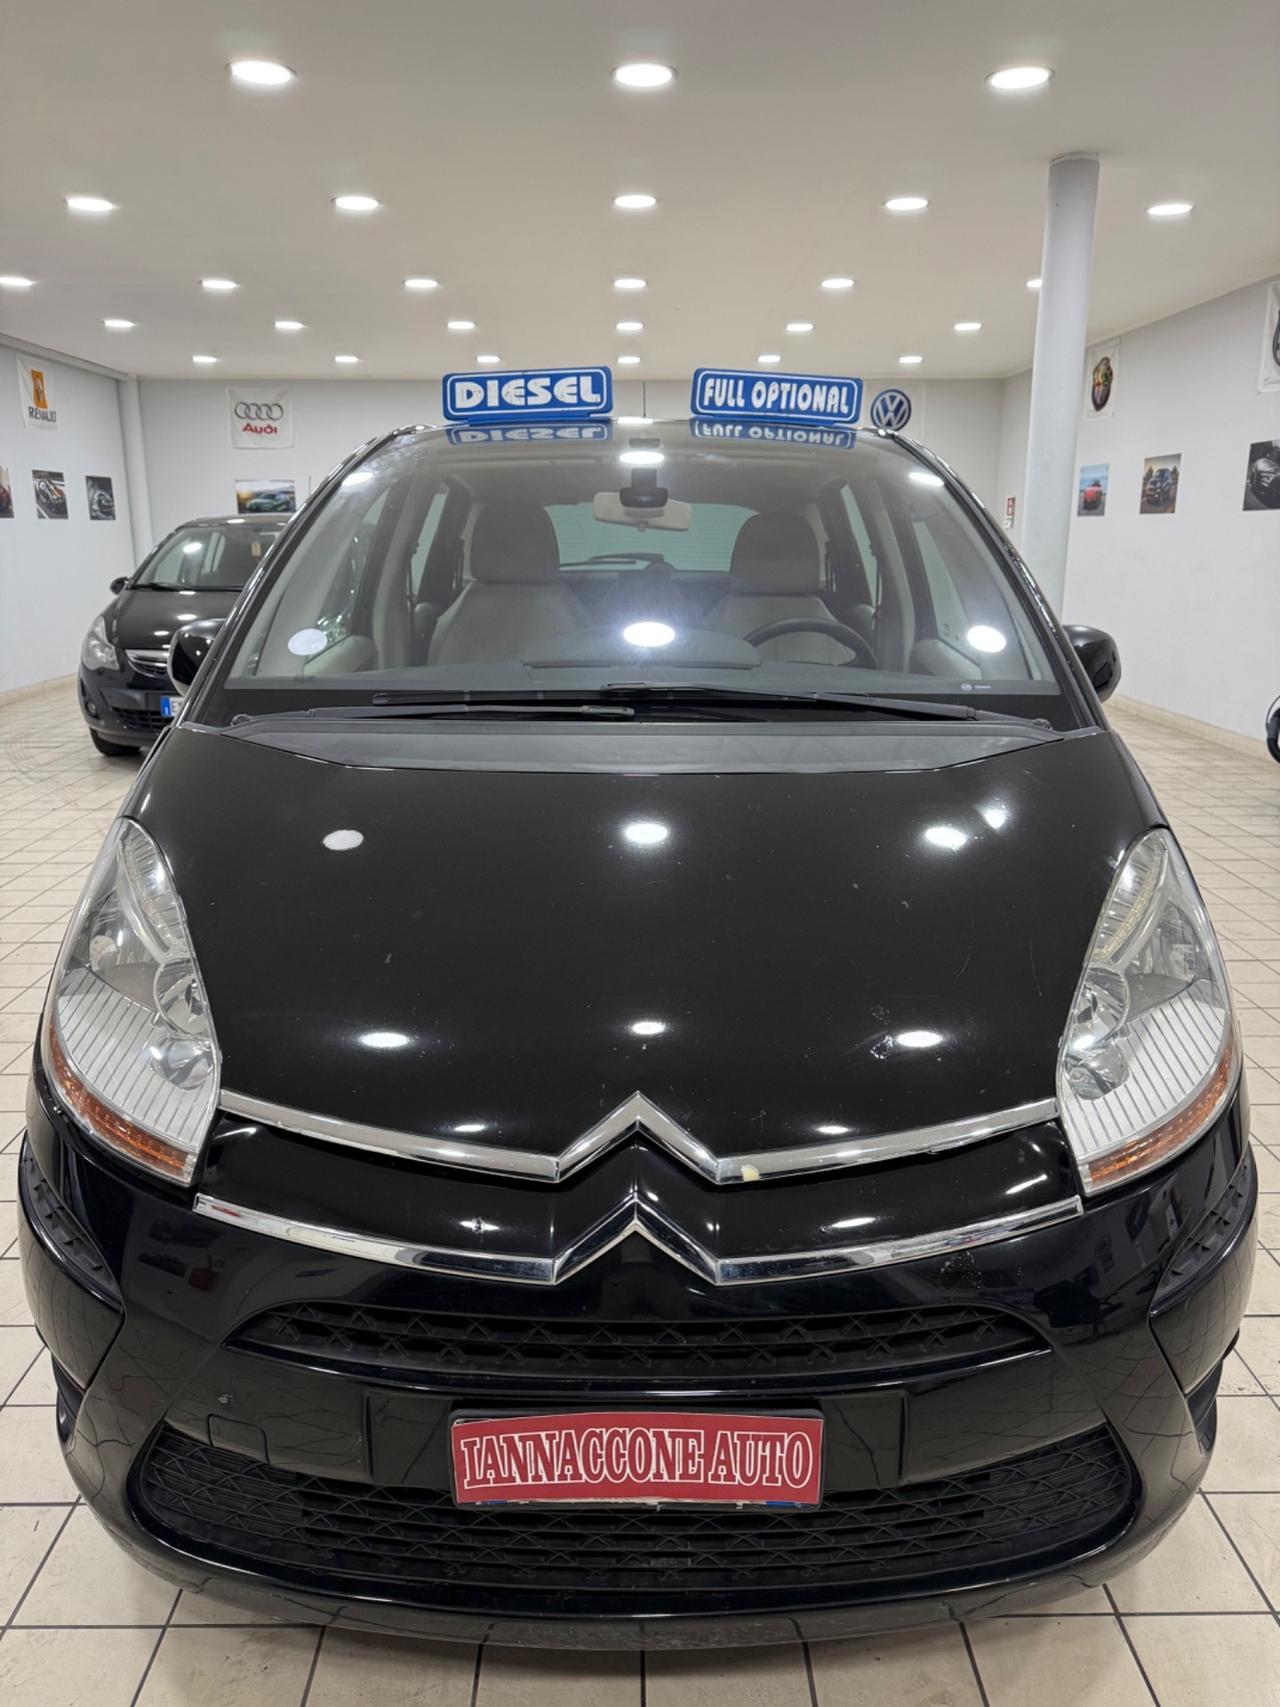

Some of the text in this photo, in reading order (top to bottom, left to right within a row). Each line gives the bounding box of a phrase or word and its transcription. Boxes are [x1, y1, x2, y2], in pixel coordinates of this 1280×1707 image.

[455, 376, 601, 408] DIESEL
[703, 378, 849, 414] FULL OPTIONAL
[242, 423, 278, 434] Audi
[461, 1427, 813, 1489] IANNACCONE AUTO
